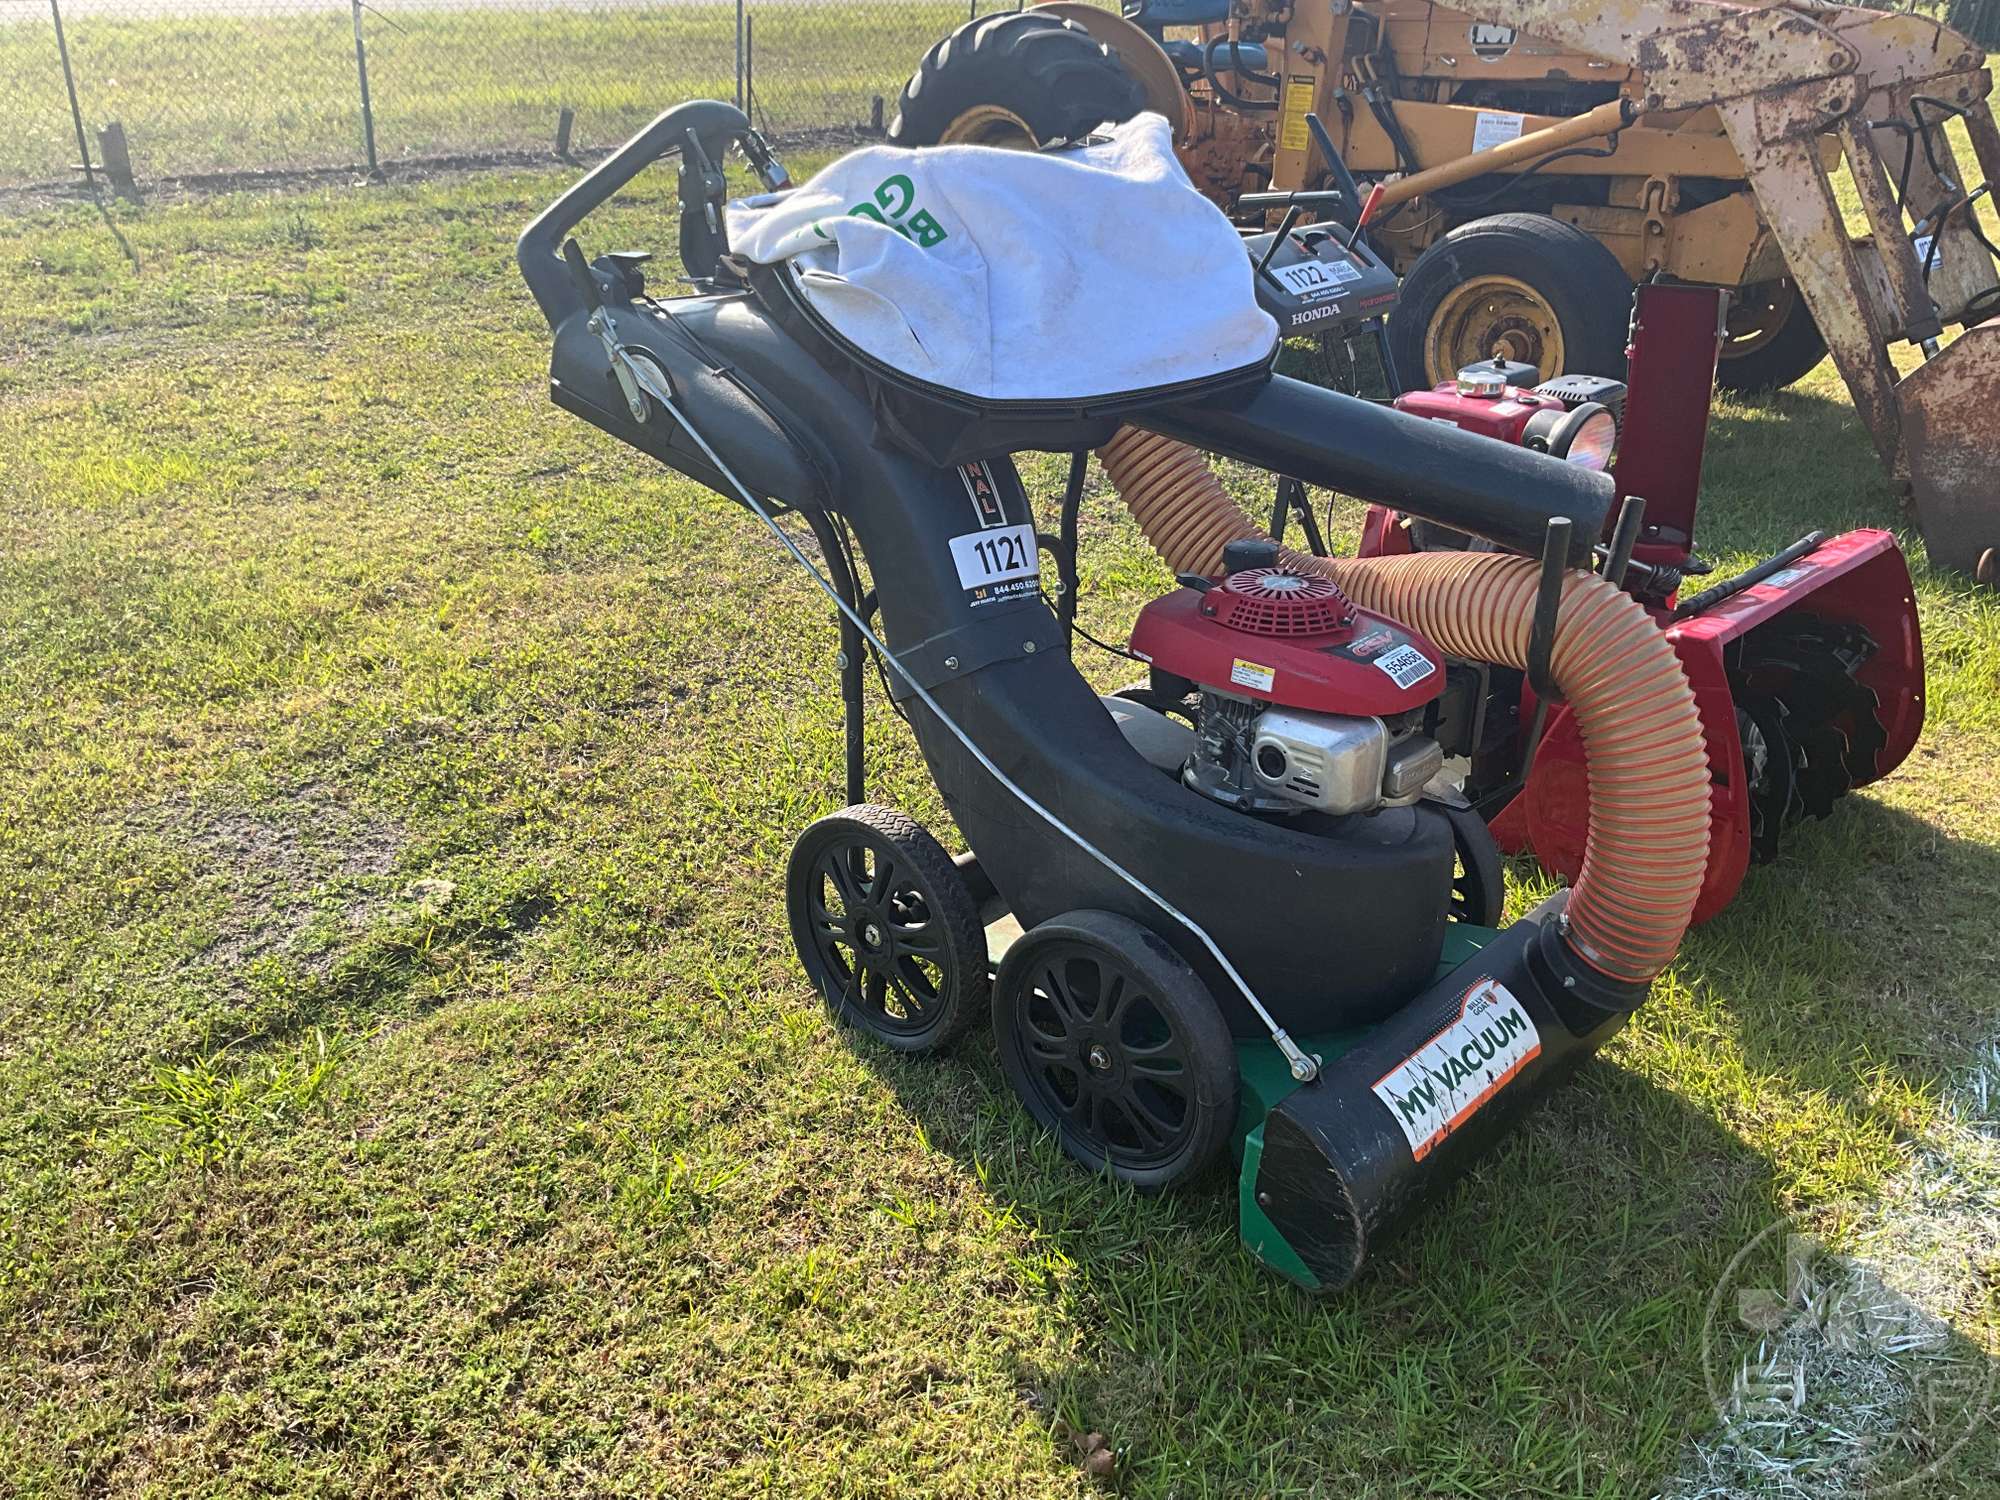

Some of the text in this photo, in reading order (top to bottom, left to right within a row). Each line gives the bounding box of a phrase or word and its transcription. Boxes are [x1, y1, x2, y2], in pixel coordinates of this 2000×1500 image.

[1284, 266, 1329, 288] 1122
[1291, 303, 1341, 325] HONDA
[974, 534, 1028, 574] 1121
[1384, 650, 1422, 675] 554656
[1472, 1001, 1490, 1016] GOAT
[1395, 1008, 1528, 1126] MV VACUUM
